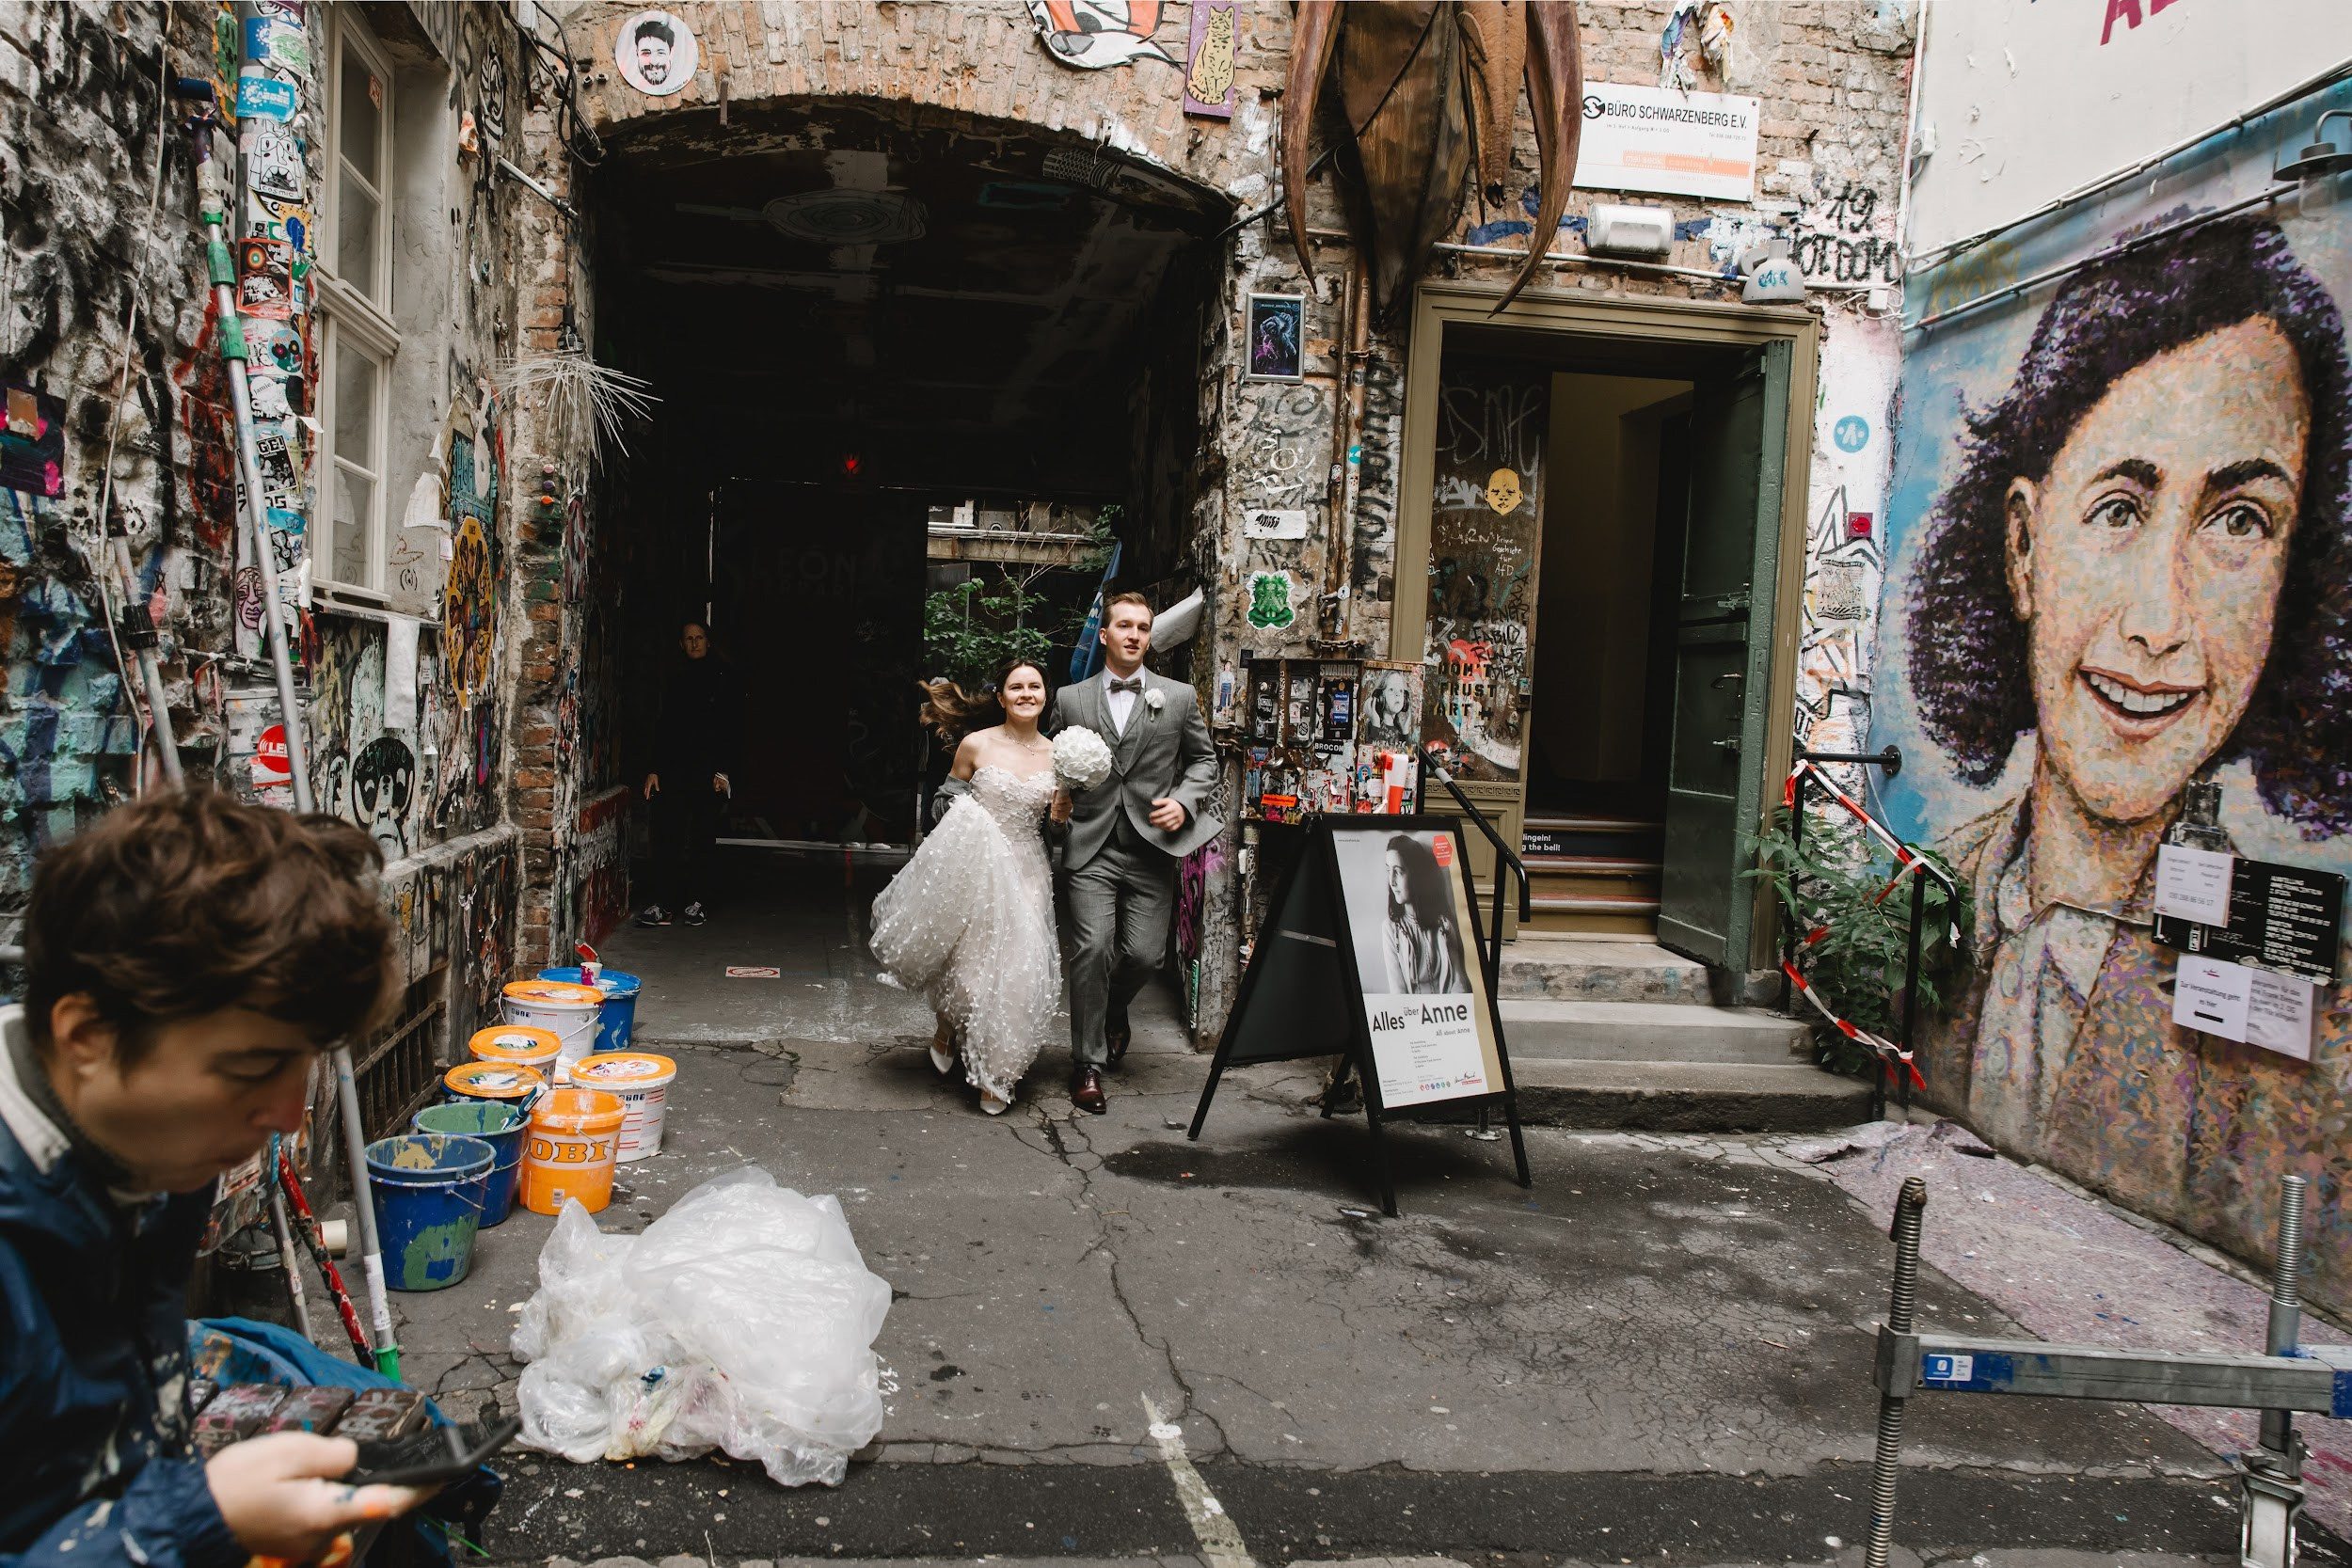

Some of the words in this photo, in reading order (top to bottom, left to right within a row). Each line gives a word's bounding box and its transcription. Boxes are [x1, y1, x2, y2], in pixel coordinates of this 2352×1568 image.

[2099, 0, 2181, 46] A
[1607, 101, 1637, 118] BÜRO
[1639, 105, 1729, 128] SCHWARZENBERG
[1730, 114, 1748, 130] E.V.
[1494, 562, 1515, 577] AfD
[1438, 682, 1497, 698] TRUST
[1434, 703, 1472, 717] ART
[268, 741, 288, 754] LE
[1522, 833, 1551, 843] lingeln!
[1528, 843, 1542, 851] the
[1544, 843, 1561, 851] bell!
[1373, 1011, 1406, 1032] Alles
[1404, 1006, 1420, 1017] über
[1422, 1003, 1468, 1025] Anne
[531, 1137, 610, 1164] OBI
